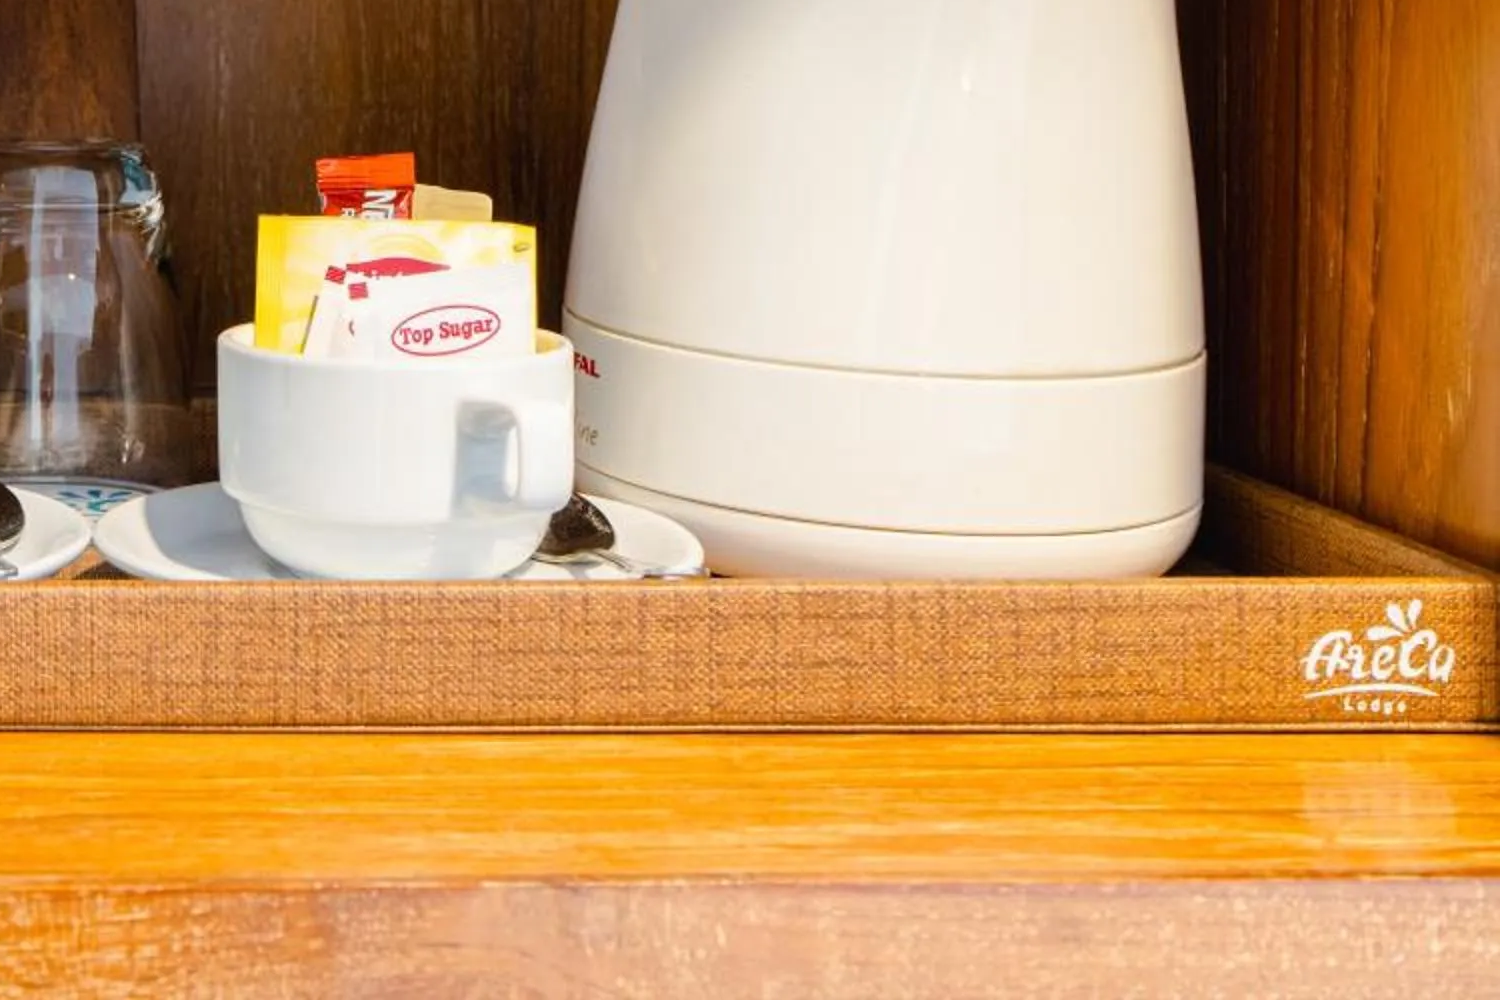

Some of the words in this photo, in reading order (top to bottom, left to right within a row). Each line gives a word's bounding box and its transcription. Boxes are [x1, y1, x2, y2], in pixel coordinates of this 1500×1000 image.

[399, 326, 435, 346] Top
[438, 318, 493, 340] Sugar
[574, 350, 601, 379] FAL
[1342, 697, 1408, 716] Lodge
